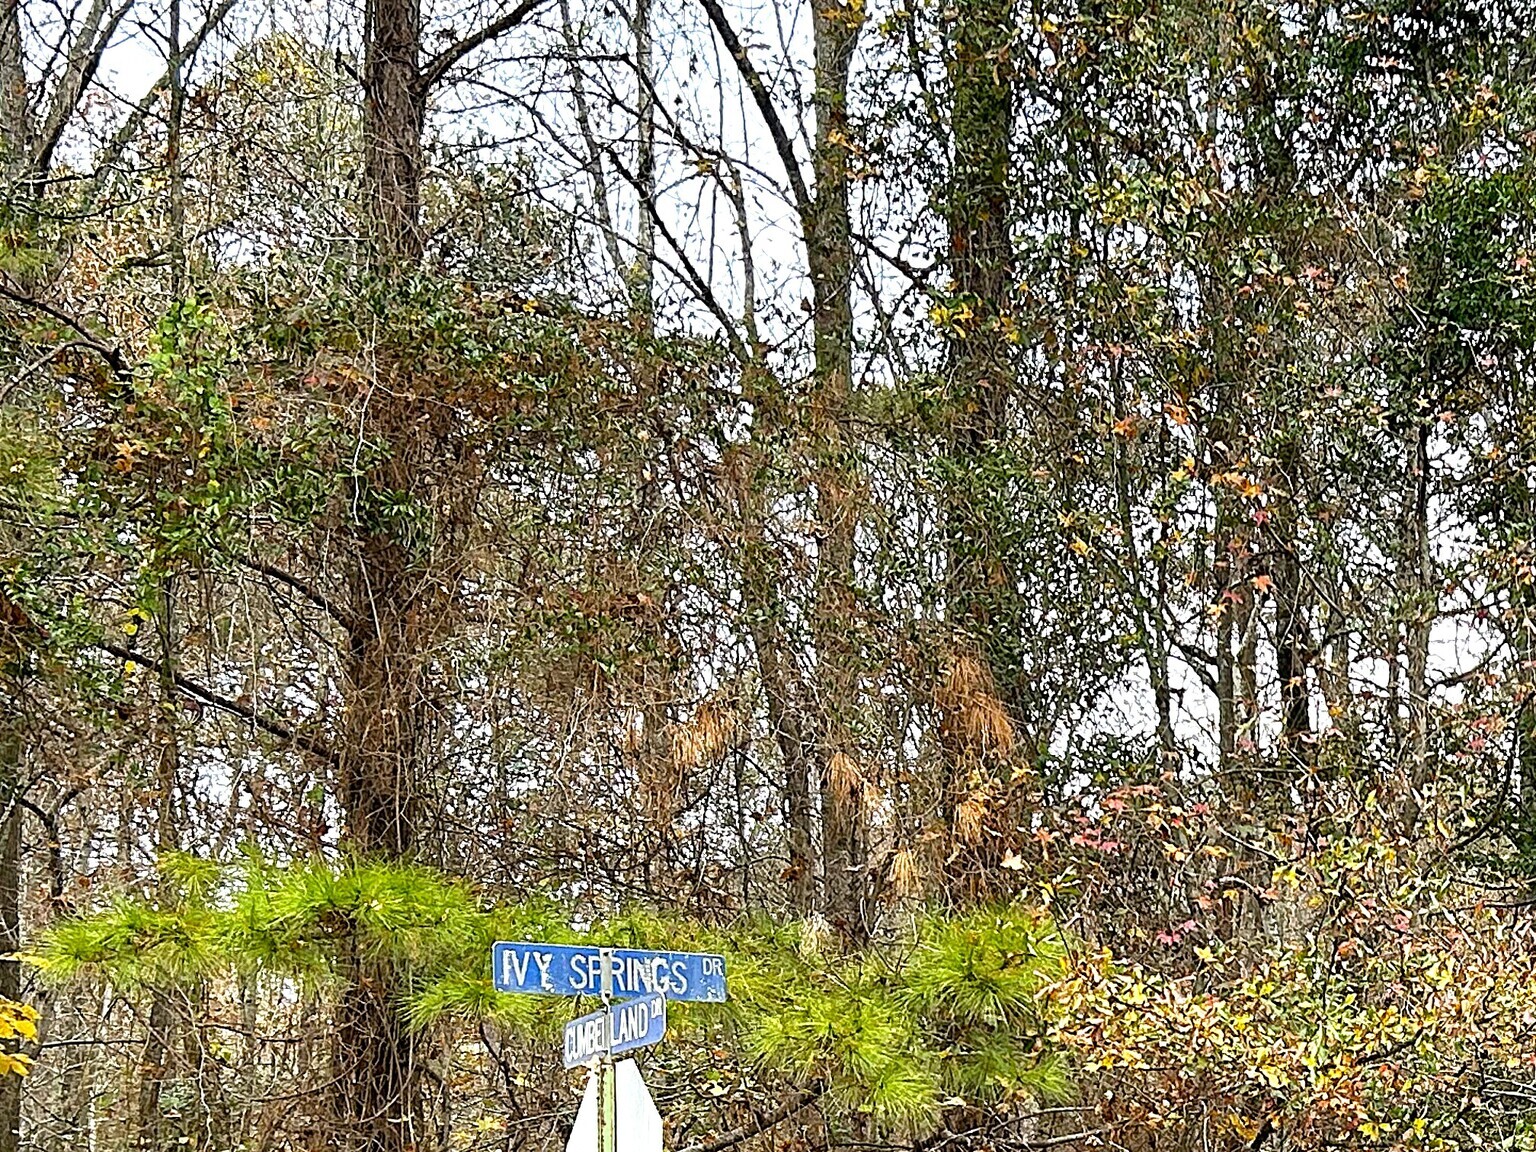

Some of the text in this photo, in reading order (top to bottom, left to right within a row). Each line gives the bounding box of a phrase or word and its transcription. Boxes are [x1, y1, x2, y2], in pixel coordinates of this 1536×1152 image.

[503, 949, 724, 994] IVY SPRINGS DR
[565, 998, 663, 1062] CUMBELAND DR
